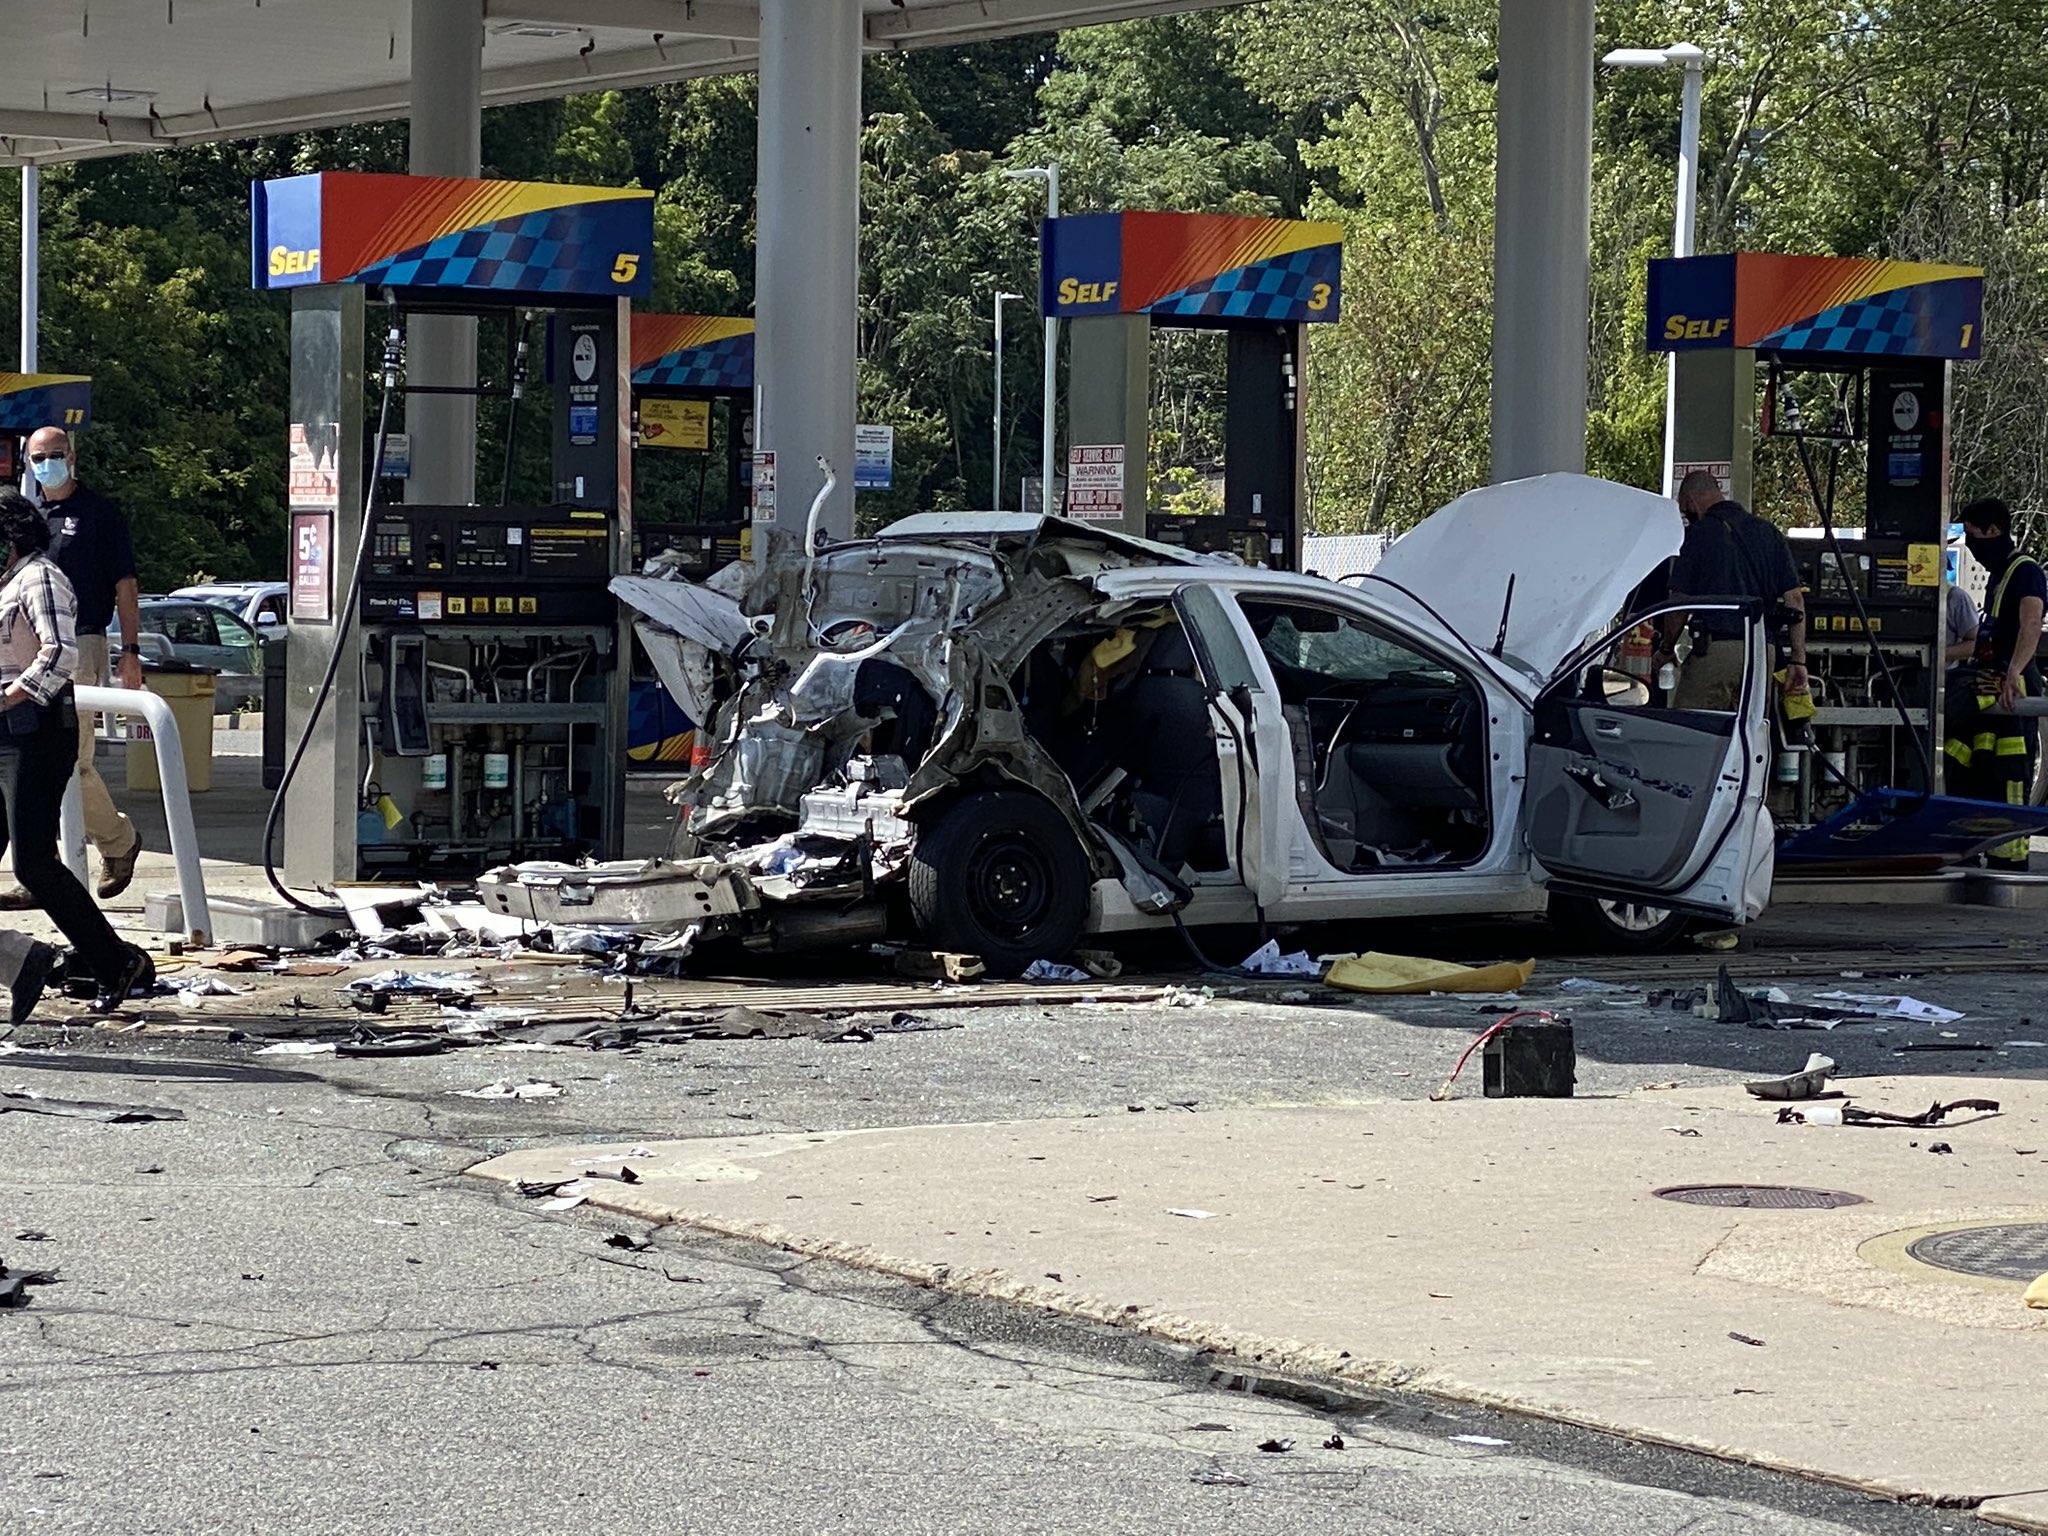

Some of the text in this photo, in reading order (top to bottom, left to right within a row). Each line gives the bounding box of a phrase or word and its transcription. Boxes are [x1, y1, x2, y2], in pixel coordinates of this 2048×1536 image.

[268, 245, 320, 277] SELF
[611, 253, 642, 284] 5
[1057, 277, 1120, 305] SELF
[1307, 283, 1332, 311] 3
[1663, 314, 1730, 341] SELF
[1959, 323, 1974, 350] 1
[64, 408, 85, 425] 11
[1075, 465, 1116, 476] WARNING
